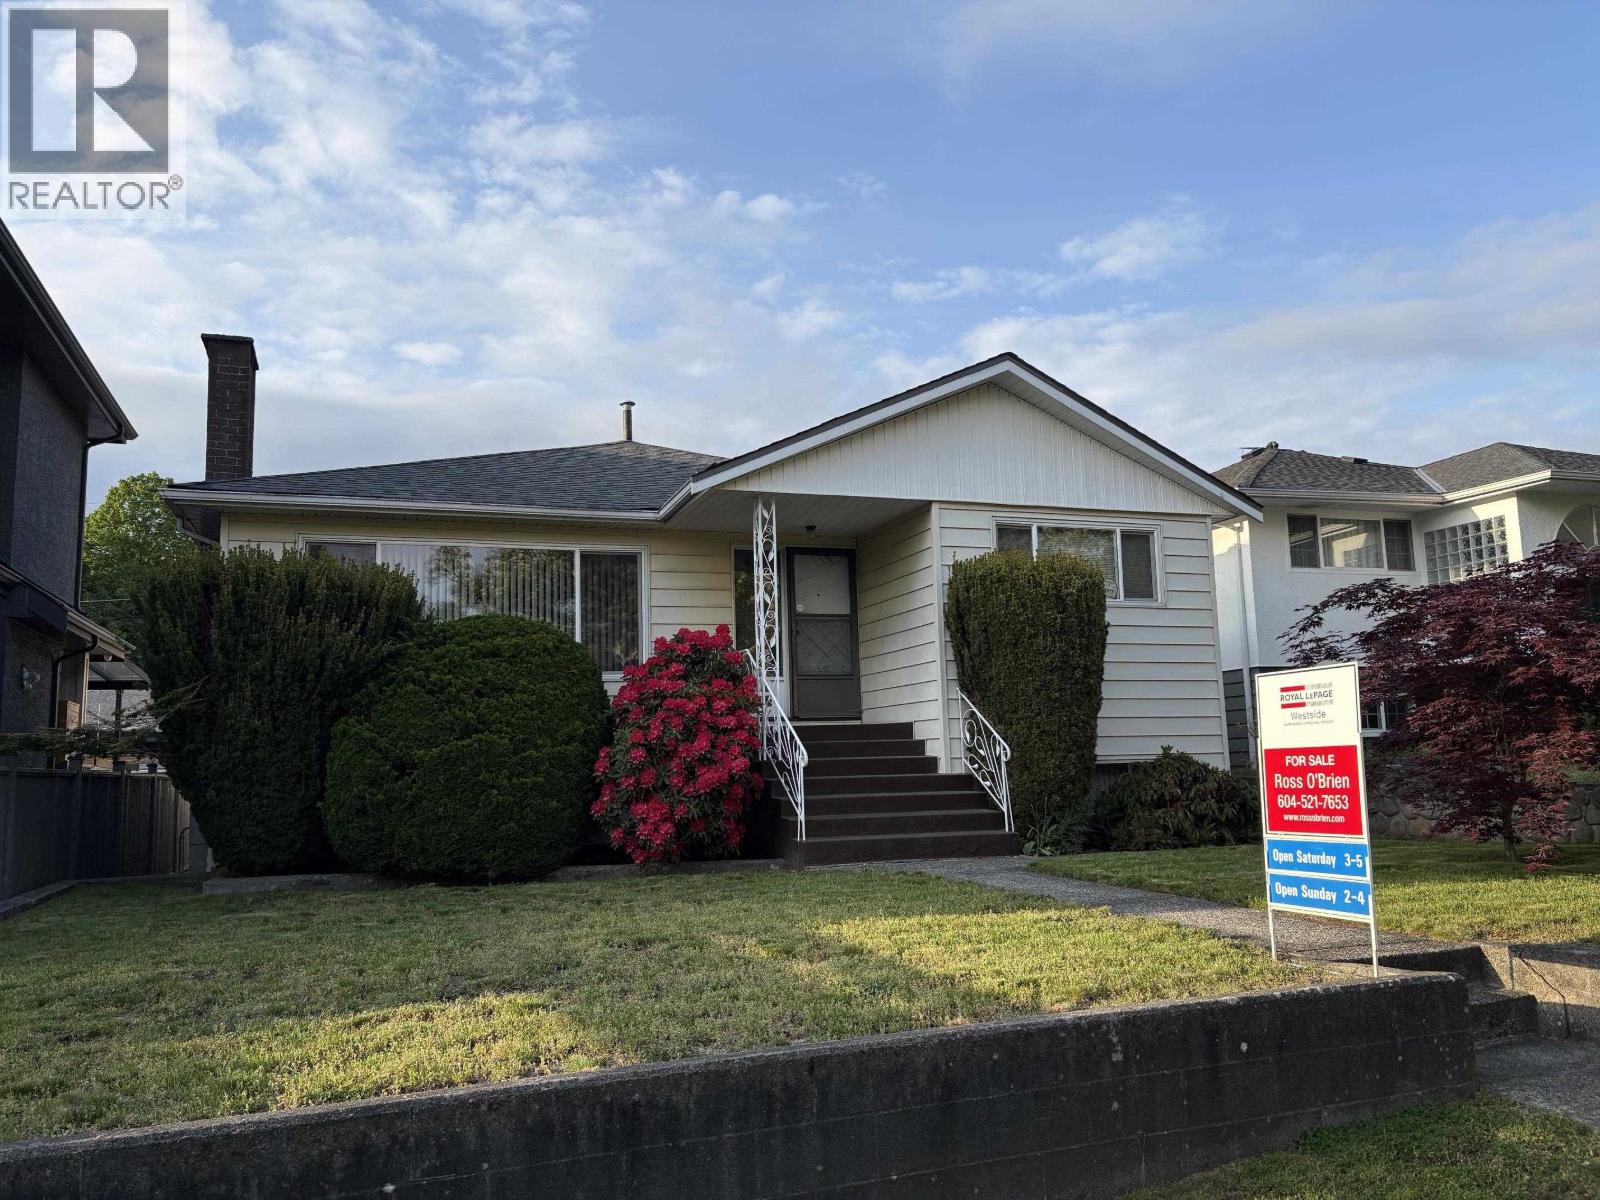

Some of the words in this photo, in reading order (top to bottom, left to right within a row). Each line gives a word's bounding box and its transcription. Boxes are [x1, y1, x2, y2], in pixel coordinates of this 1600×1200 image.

[1280, 692, 1304, 702] ROYAL
[1290, 710, 1326, 721] Westside
[1285, 755, 1306, 767] FOR
[1308, 754, 1335, 766] SALE
[1274, 773, 1303, 789] Ross
[1306, 772, 1350, 789] O'Brien
[1277, 794, 1349, 810] 604-521-7653
[1283, 813, 1345, 823] www.rossobrien.com
[1273, 849, 1294, 864] Open
[1296, 850, 1336, 868] Saturday
[1344, 853, 1363, 868] 3-5
[1275, 882, 1298, 897] Open
[1301, 885, 1337, 904] Sunday
[1344, 890, 1366, 905] 2-4
